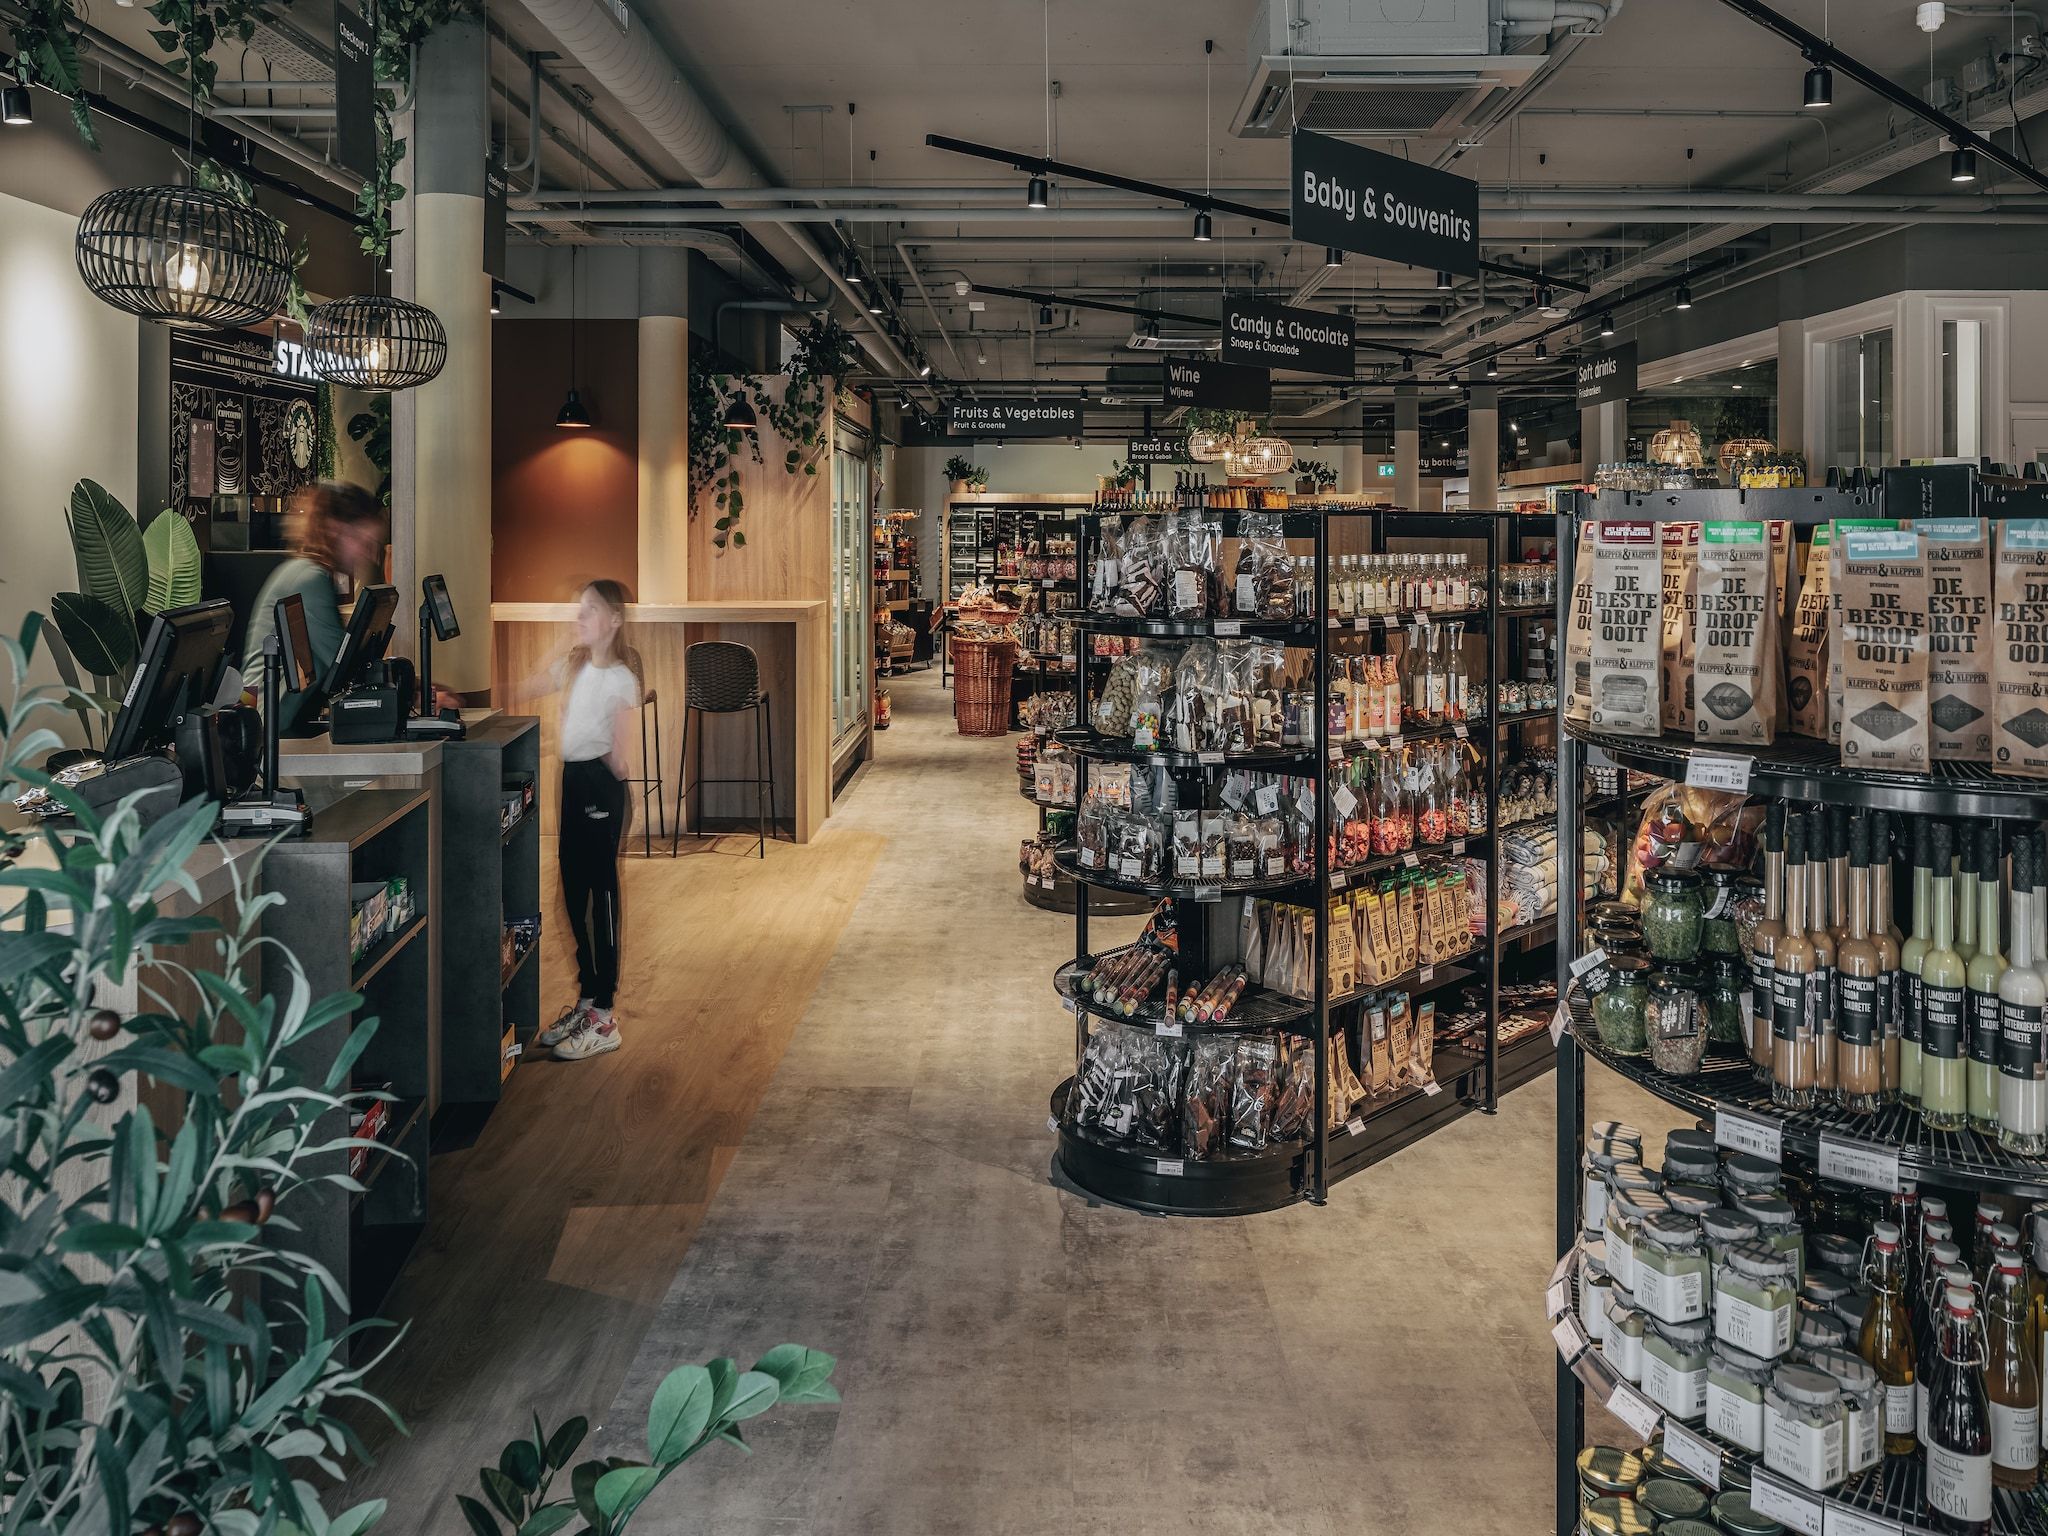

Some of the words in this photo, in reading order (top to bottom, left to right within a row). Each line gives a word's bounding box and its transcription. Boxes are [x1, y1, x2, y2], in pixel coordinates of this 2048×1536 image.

[340, 22, 364, 52] Checkout
[365, 43, 369, 55] 2
[1304, 170, 1356, 222] Baby
[1364, 187, 1377, 219] &
[1384, 192, 1471, 242] Souvenirs
[1230, 312, 1271, 339] Candy
[1275, 320, 1284, 337] &
[1288, 321, 1349, 346] Chocolate
[1230, 337, 1254, 351] Snoep
[1255, 340, 1261, 350] &
[1262, 341, 1300, 356] Chocolade
[1170, 365, 1200, 383] Wine
[1578, 365, 1593, 382] Soft
[1594, 356, 1617, 378] drinks
[1170, 386, 1194, 398] Wijnen
[954, 406, 988, 419] Fruits
[992, 407, 1002, 419] &
[1005, 406, 1075, 422] Vegetables
[1132, 442, 1159, 452] Bread
[1164, 442, 1172, 452] &
[1598, 551, 1622, 559] KLEPPER
[1622, 548, 1630, 560] &
[1704, 552, 1728, 560] KLEPPER
[1729, 549, 1738, 561] &
[1740, 552, 1764, 560] KLEPPER
[1940, 547, 1950, 561] &
[1952, 549, 1982, 558] KLEPPER
[2003, 553, 2034, 564] KLEPPER
[2036, 551, 2046, 566] &
[1848, 565, 1877, 574] KLEPPER
[1879, 563, 1888, 577] &
[1890, 567, 1921, 576] KLEPPER
[1615, 576, 1638, 591] DE
[1663, 575, 1680, 589] DE
[1722, 578, 1746, 593] DE
[1933, 578, 1962, 595] DE
[1595, 592, 1657, 608] BESTE
[1701, 594, 1764, 611] BESTE
[1870, 593, 1900, 609] DE
[1928, 596, 1986, 614] ESTE
[1600, 609, 1651, 625] DROP
[1664, 606, 1682, 620] OP
[1706, 612, 1758, 628] DROP
[1848, 609, 1924, 628] BESTE
[2000, 603, 2048, 622] BES
[1602, 626, 1648, 642] OOIT
[1708, 630, 1754, 646] OOIT
[1855, 625, 1918, 645] DROP
[1858, 645, 1913, 664] OOIT
[1596, 659, 1619, 667] KLEPPER
[1620, 657, 1627, 669] &
[1629, 660, 1654, 669] KLEPPER
[1700, 664, 1724, 673] KLEPPER
[1725, 663, 1732, 675] &
[1735, 666, 1759, 676] KLEPPER
[1945, 670, 1954, 684] &
[1957, 673, 1986, 683] KLEPPER
[1848, 679, 1878, 688] KLEPPER
[1879, 679, 1888, 691] &
[1891, 681, 1920, 690] KLEPPER
[2000, 684, 2030, 694] KLEPPER
[2032, 682, 2042, 696] &
[1335, 936, 1352, 946] BESTE
[1338, 944, 1351, 952] DROP
[1844, 978, 1874, 991] CAPPUCCINO
[1844, 989, 1859, 1000] ROOM
[1928, 989, 1961, 1002] LIMONCELLO
[1980, 996, 1999, 1008] LIMON
[1844, 999, 1871, 1013] LIKORETTE
[1928, 1000, 1944, 1012] ROOM
[1980, 1007, 1996, 1019] ROOM
[2004, 1006, 2025, 1020] VANILLE
[1928, 1011, 1957, 1024] LIKORETTE
[1980, 1018, 2000, 1031] LIKORE
[2004, 1018, 2041, 1033] BITTERKOEKJES
[2004, 1029, 2031, 1044] LIKORETTE
[1728, 1322, 1752, 1346] KERRIE
[1650, 1382, 1669, 1403] KERRIE
[1718, 1415, 1742, 1438] KERRIE
[1938, 1477, 1955, 1491] SIROOP
[1931, 1482, 1968, 1517] KERSEN
[1806, 1522, 1819, 1532] 4,40
